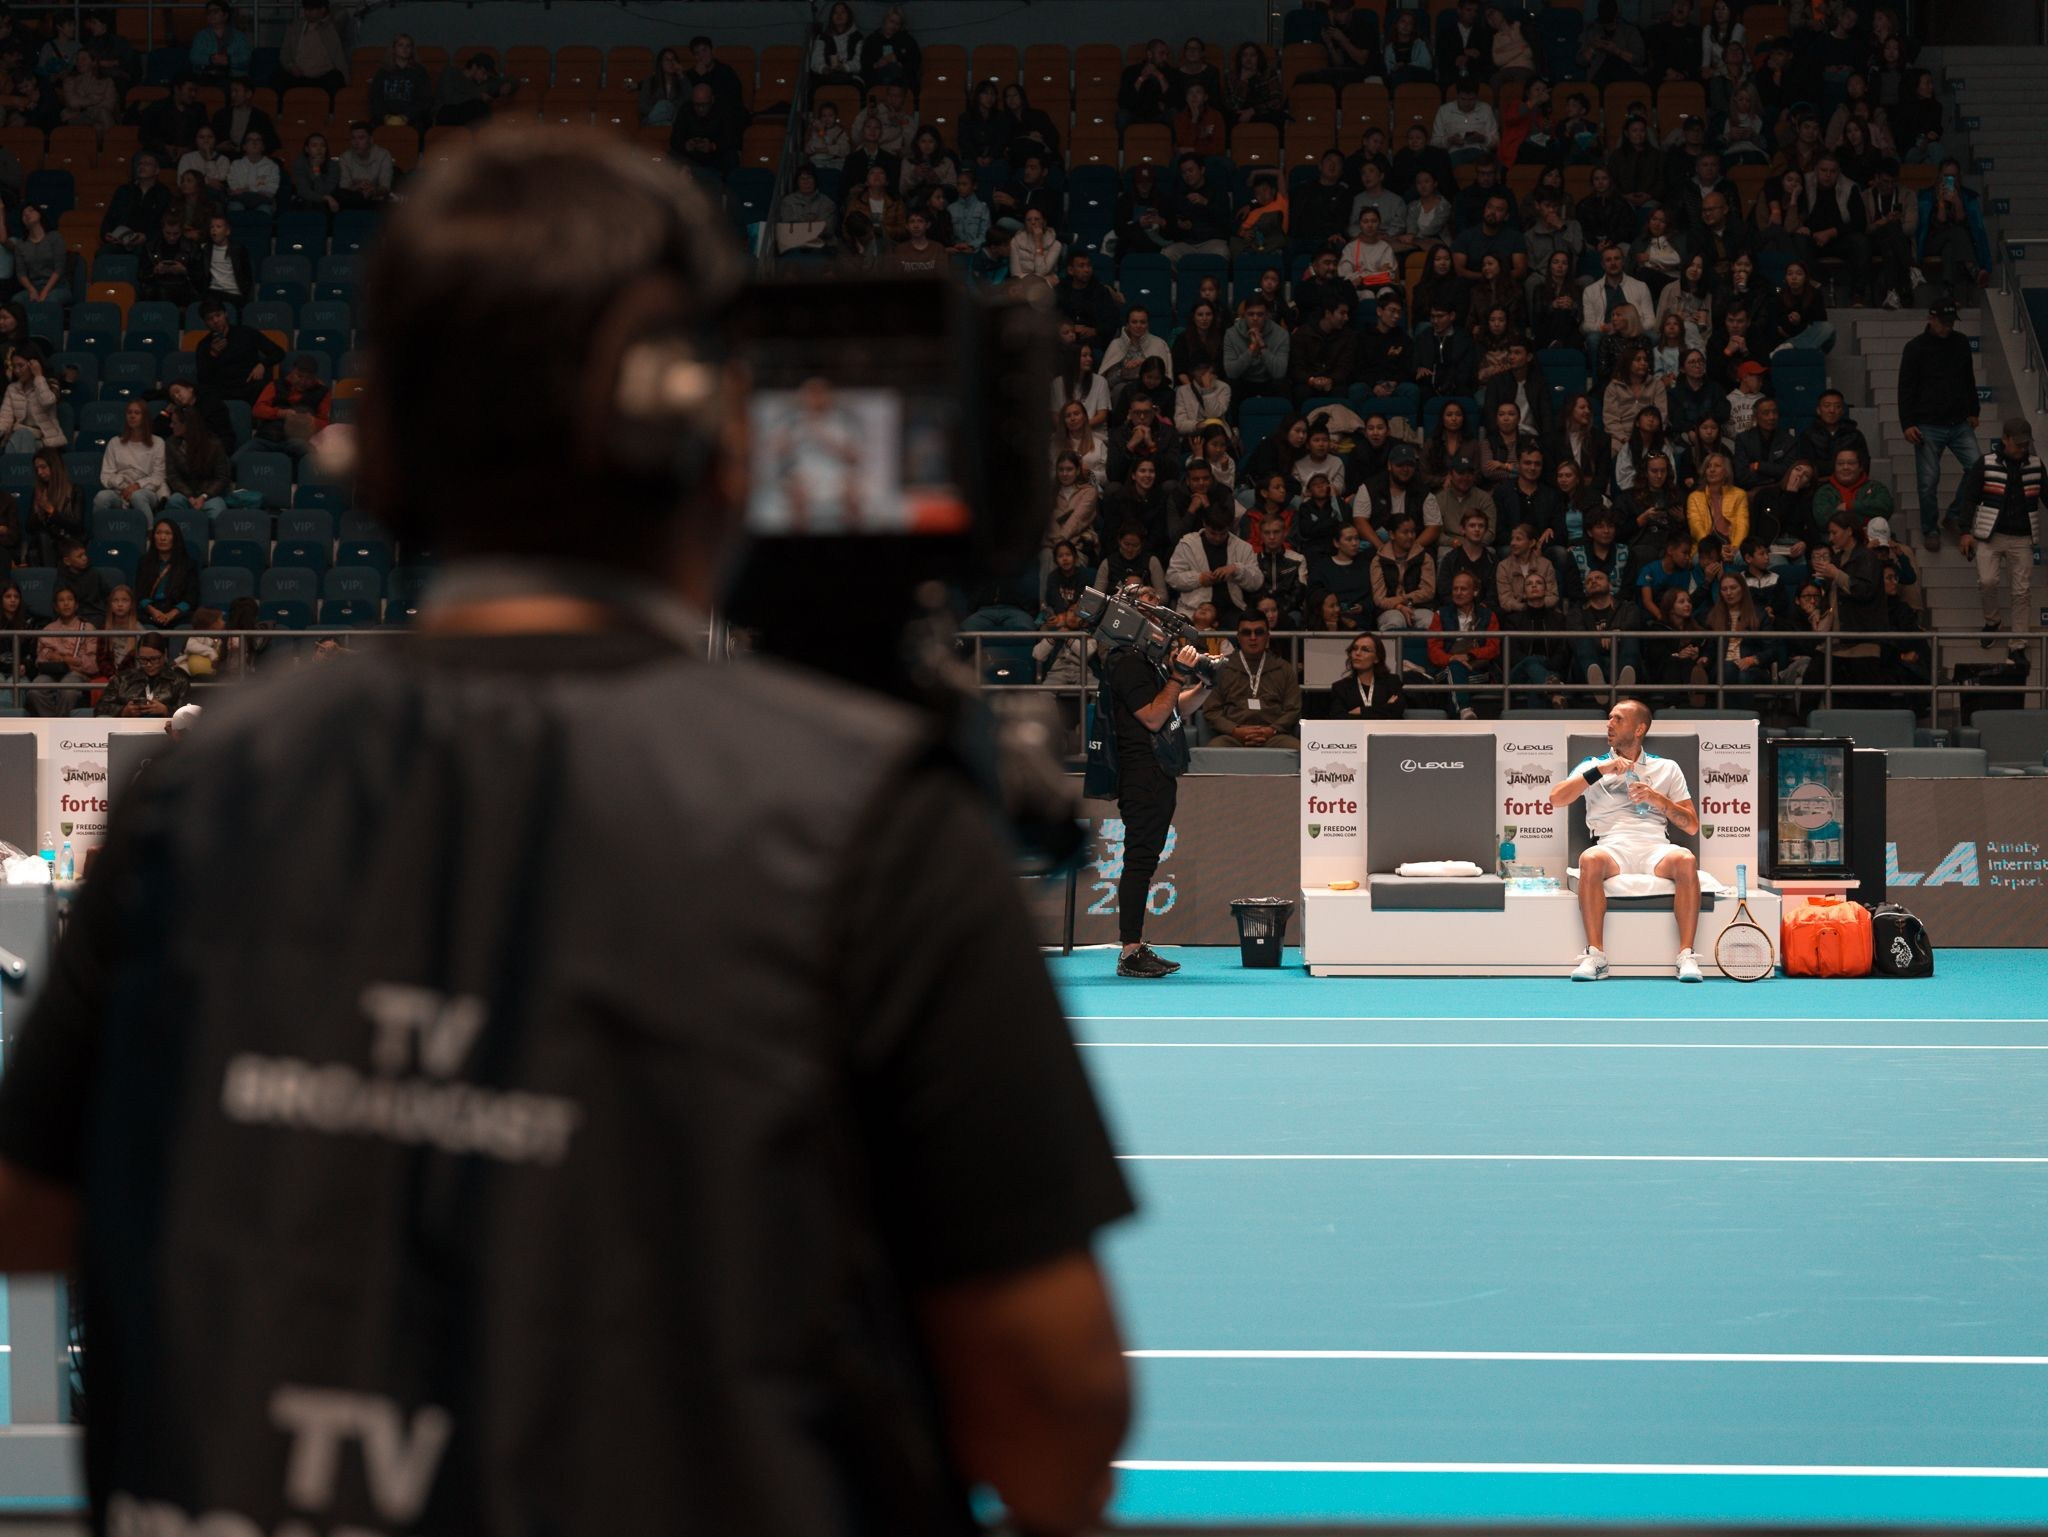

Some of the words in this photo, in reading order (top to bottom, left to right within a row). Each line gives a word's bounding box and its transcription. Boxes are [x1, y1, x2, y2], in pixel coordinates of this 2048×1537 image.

[2010, 249, 2024, 257] 10
[10, 465, 30, 475] VIP
[73, 465, 91, 475] VIP
[252, 465, 271, 475] VIP
[108, 521, 127, 531] VIP
[233, 521, 252, 531] VIP
[293, 521, 312, 531] VIP
[21, 580, 40, 590] VIP
[213, 580, 232, 589] VIP
[276, 580, 296, 590] VIP
[340, 579, 360, 590] VIP
[1112, 619, 1121, 629] 8
[1417, 761, 1465, 769] LEXUS
[63, 771, 107, 782] JANYMDA
[1310, 772, 1355, 784] JANYMDA
[1506, 773, 1551, 785] JANYMDA
[1704, 773, 1748, 784] JANYMDA
[60, 795, 109, 812] forte
[1308, 796, 1357, 814] forte
[1504, 797, 1553, 815] forte
[1701, 796, 1751, 814] forte
[360, 980, 487, 1078] TV
[268, 1384, 452, 1524] TV
